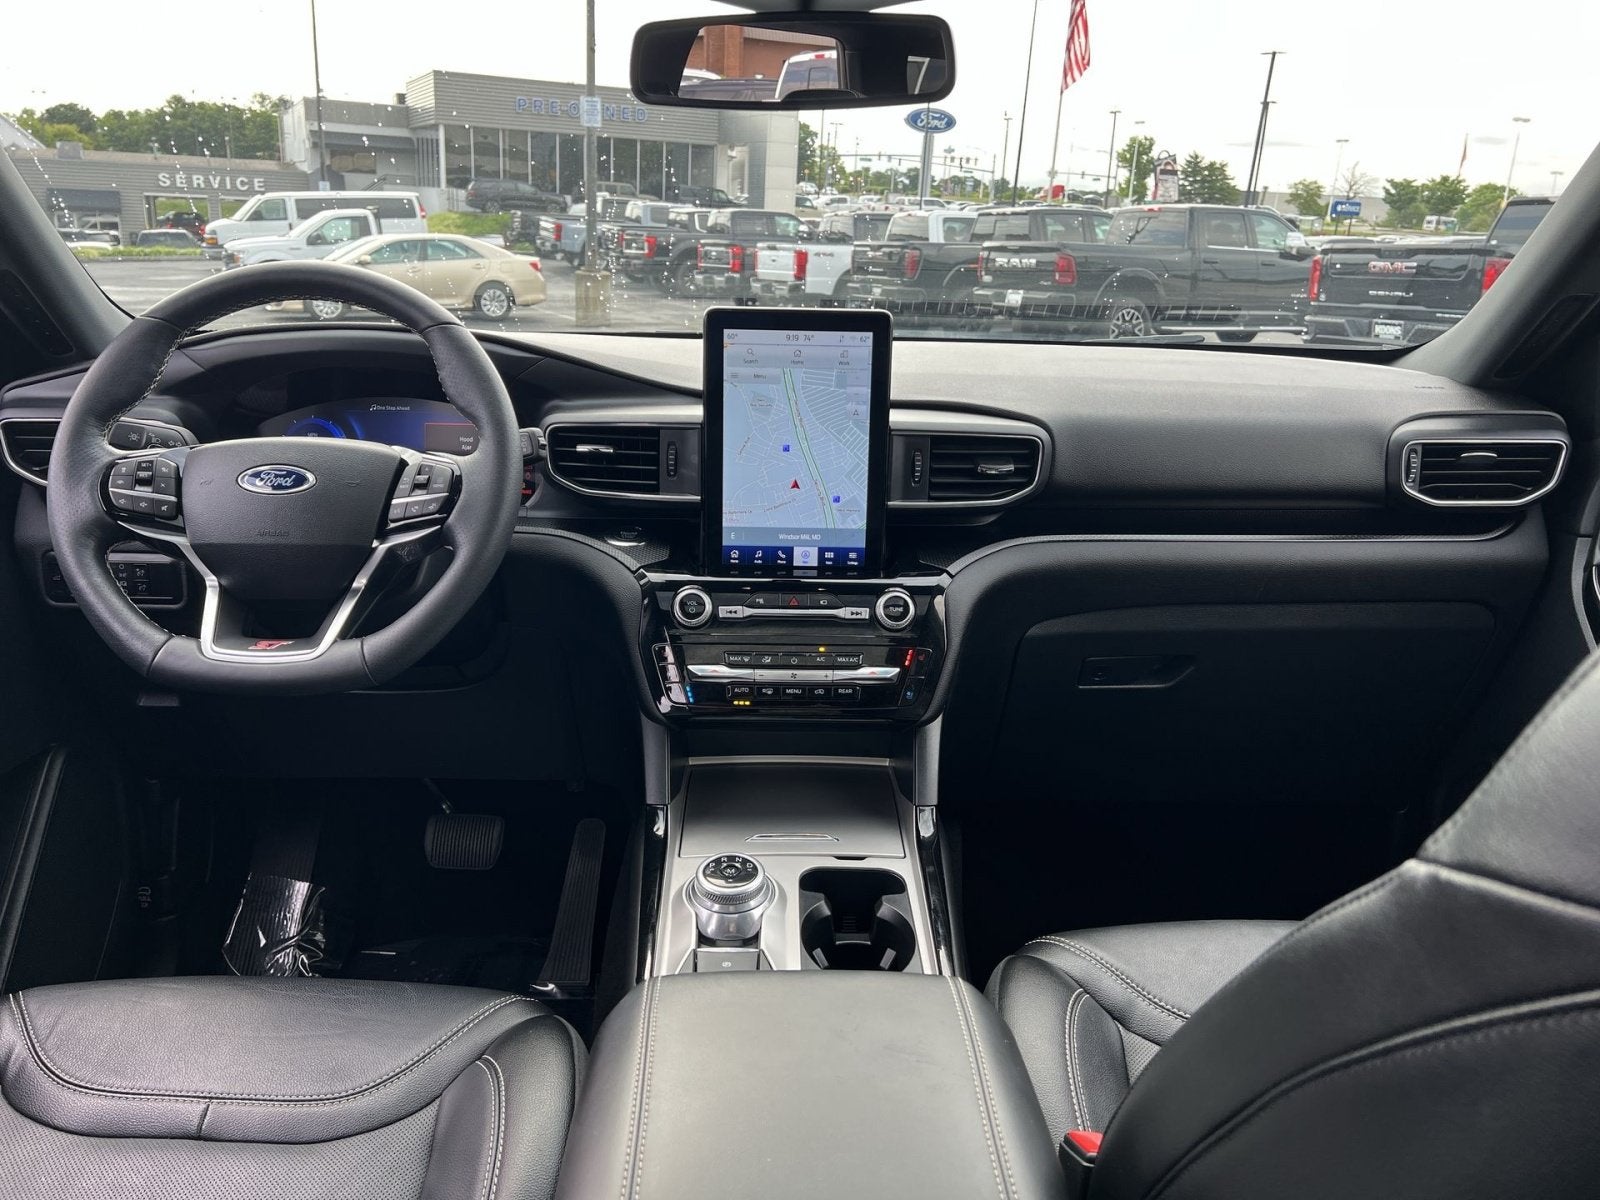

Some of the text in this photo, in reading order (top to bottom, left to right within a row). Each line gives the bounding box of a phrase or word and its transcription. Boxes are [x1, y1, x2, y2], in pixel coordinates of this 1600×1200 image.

[515, 96, 648, 123] PRE-ONED
[158, 173, 266, 191] SERVICE
[994, 257, 1037, 268] RAM
[1367, 261, 1418, 274] GMC
[255, 470, 296, 487] Ford
[253, 640, 294, 650] ST
